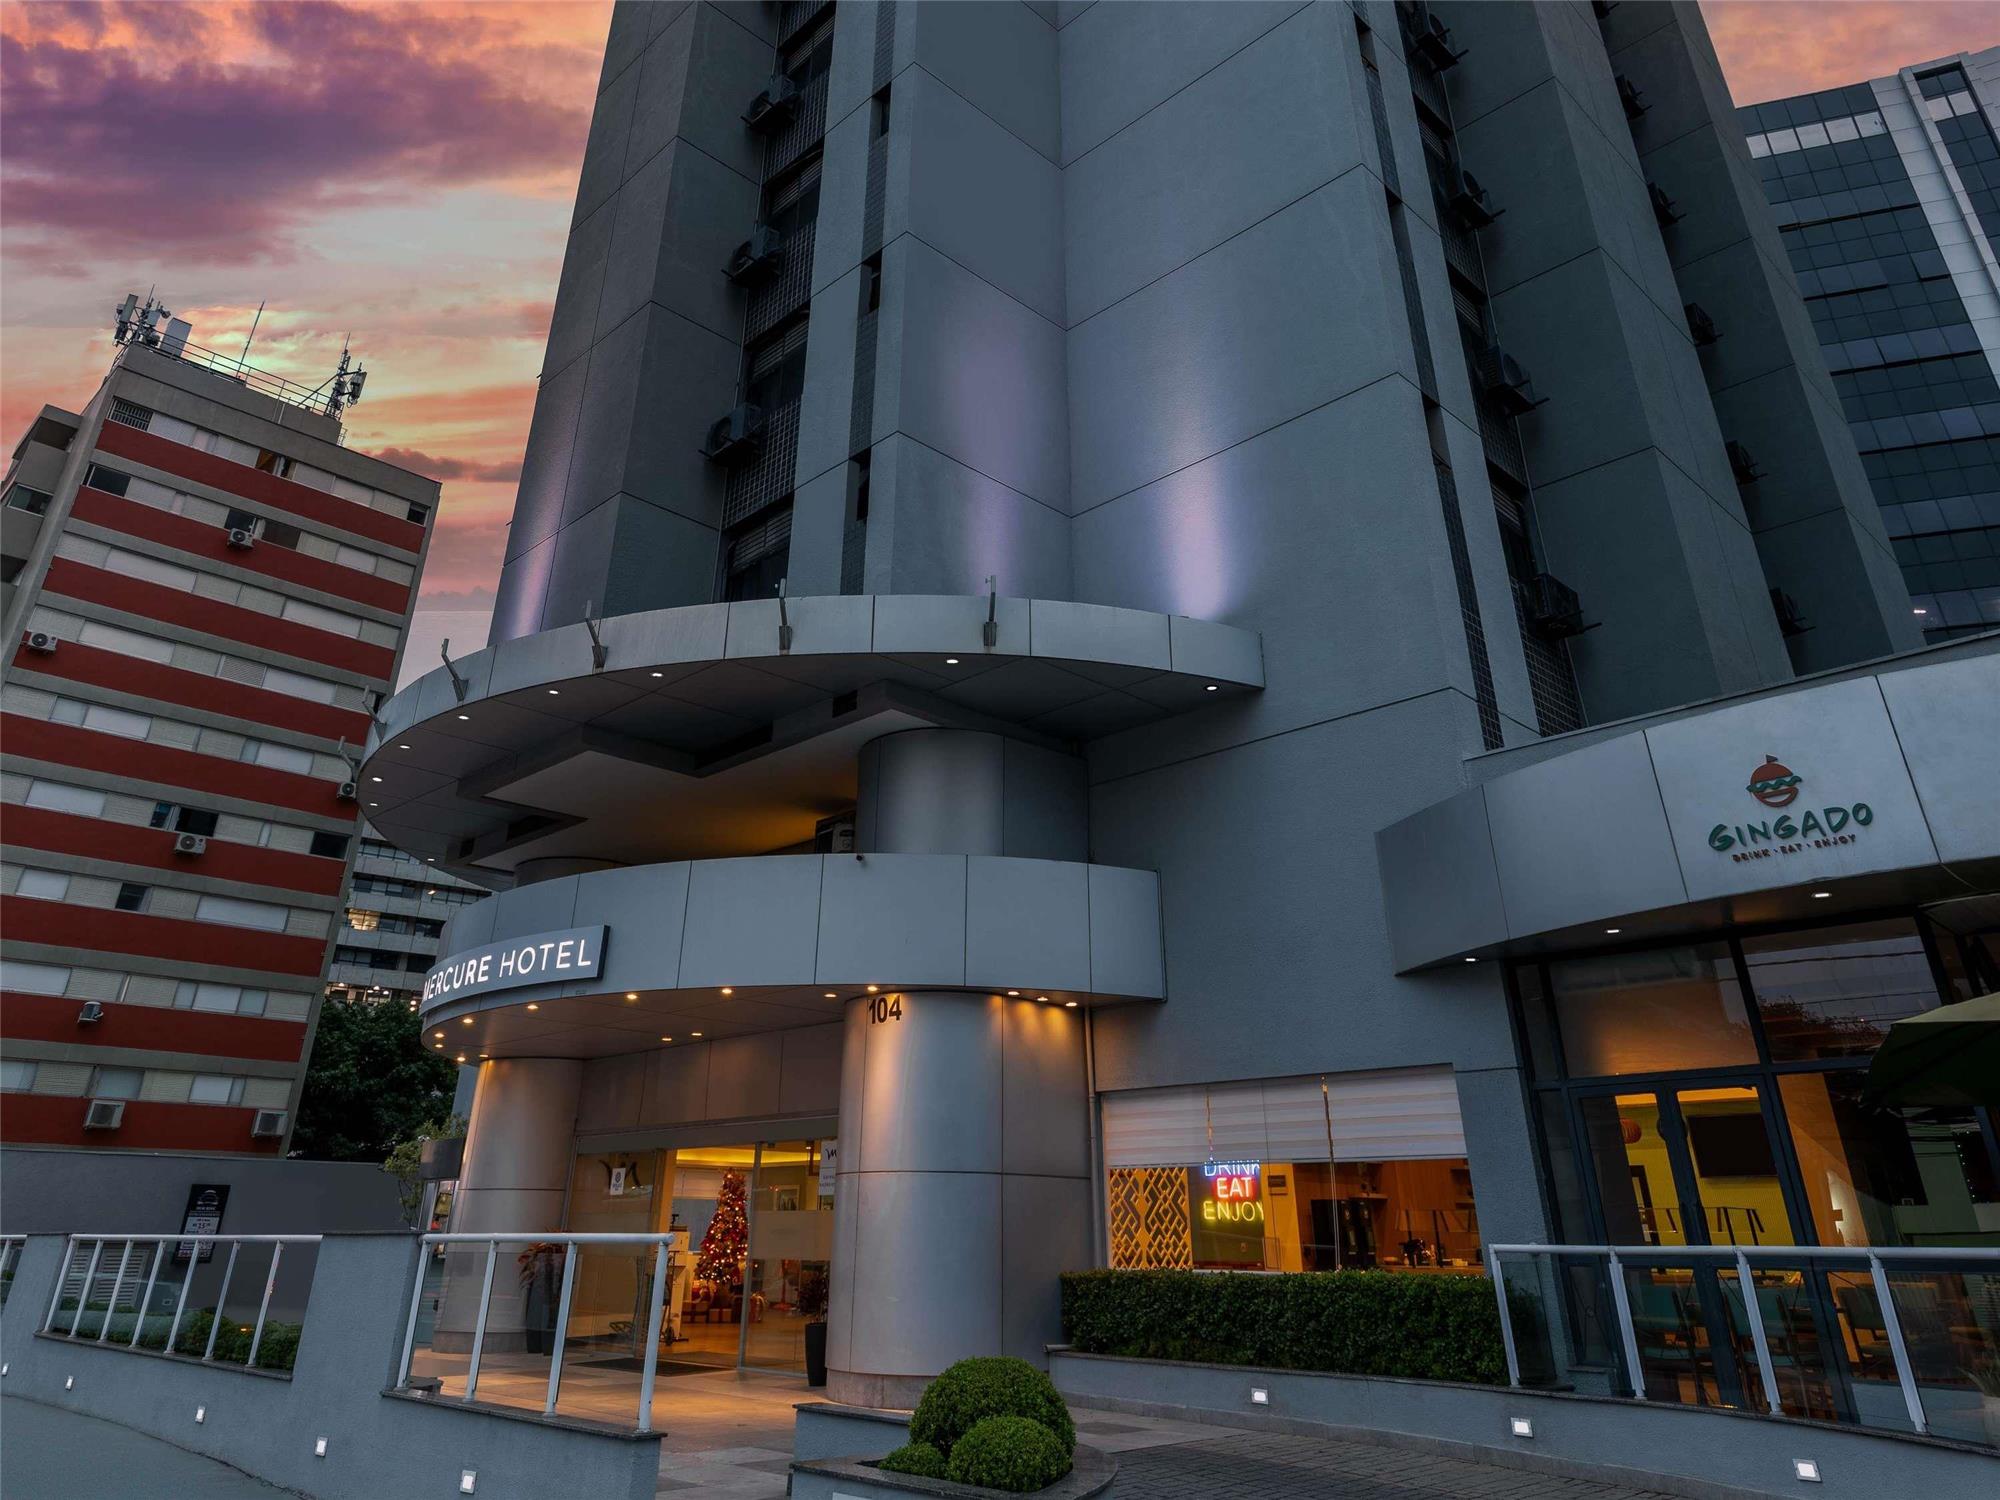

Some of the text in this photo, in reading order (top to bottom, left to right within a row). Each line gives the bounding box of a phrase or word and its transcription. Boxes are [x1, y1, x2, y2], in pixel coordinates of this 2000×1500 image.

[1708, 803, 1873, 851] GINGADO
[1732, 834, 1856, 862] DRINK EAT ENJOY
[423, 939, 592, 1001] MERCURE HOTEL
[869, 994, 902, 1024] 104
[1217, 1177, 1252, 1198] EAT
[1203, 1201, 1265, 1221] ENJOY
